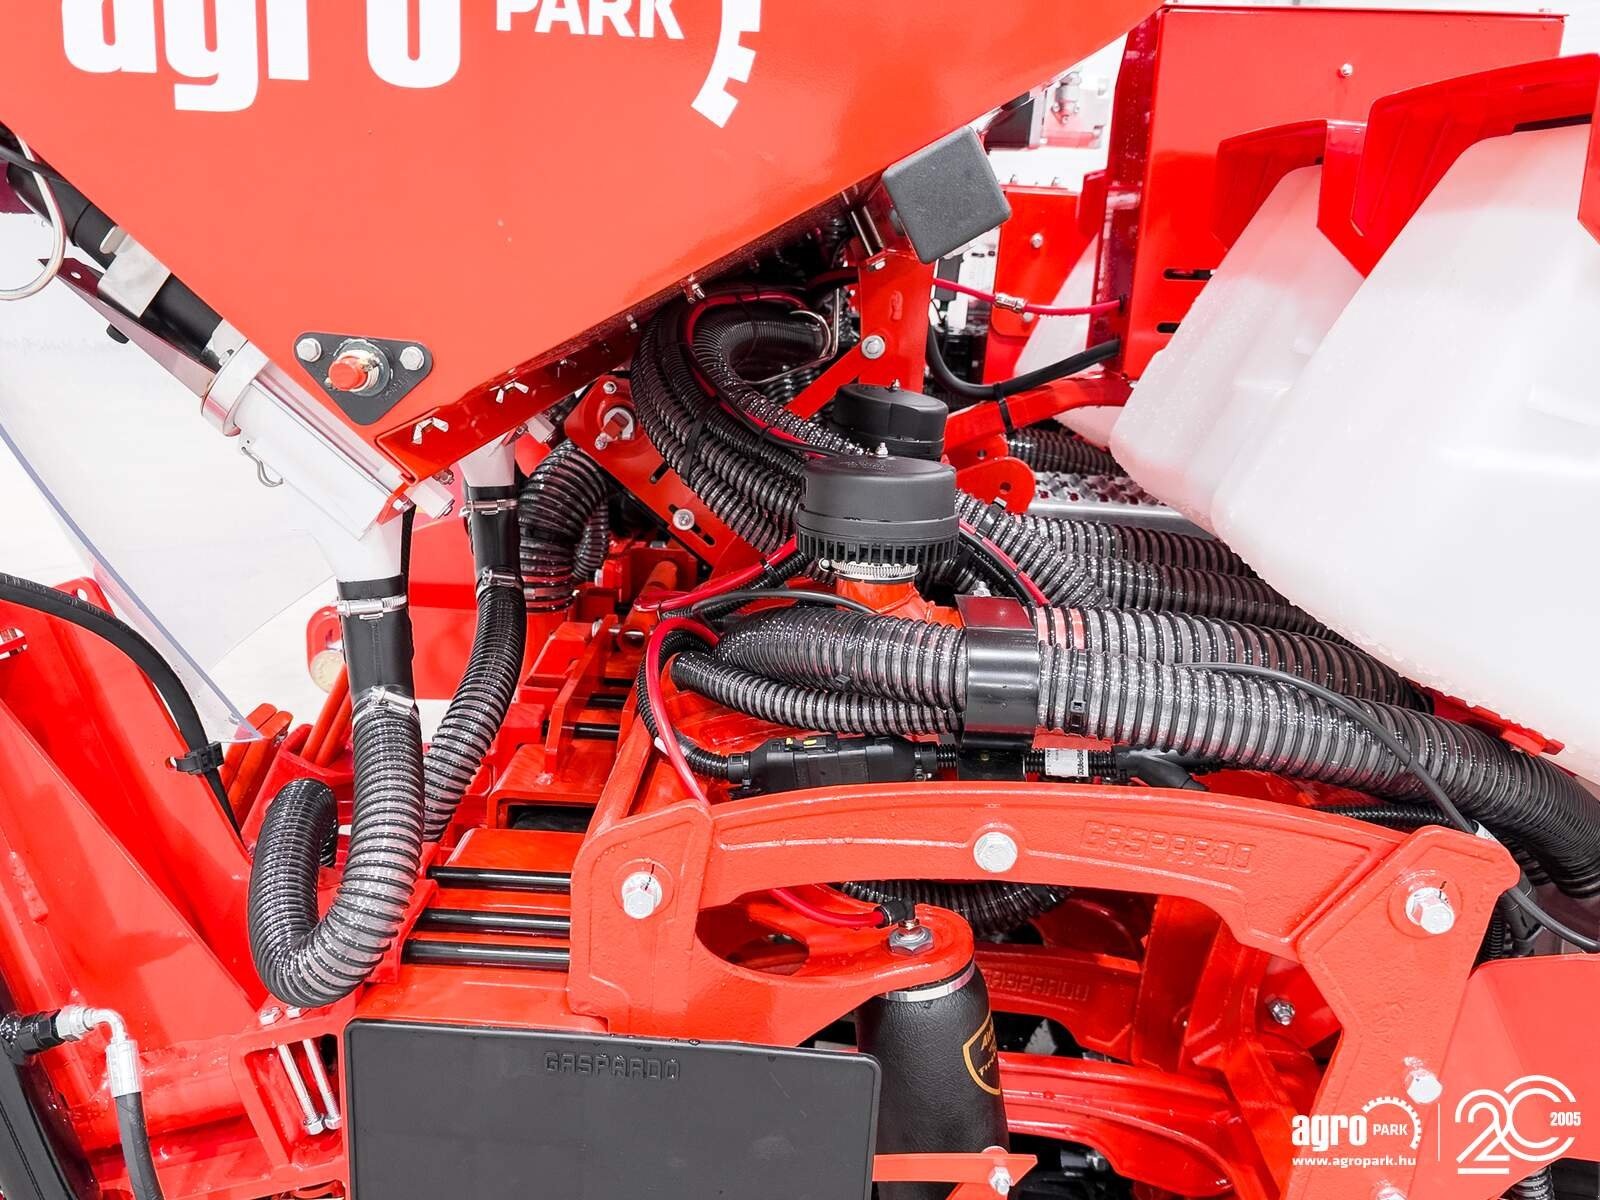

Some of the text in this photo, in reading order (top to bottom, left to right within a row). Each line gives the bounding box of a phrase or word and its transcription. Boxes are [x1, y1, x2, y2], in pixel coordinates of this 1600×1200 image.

[496, 0, 684, 39] PARK
[1080, 820, 1256, 873] GASPARDO
[544, 1051, 681, 1081] GASPARDO
